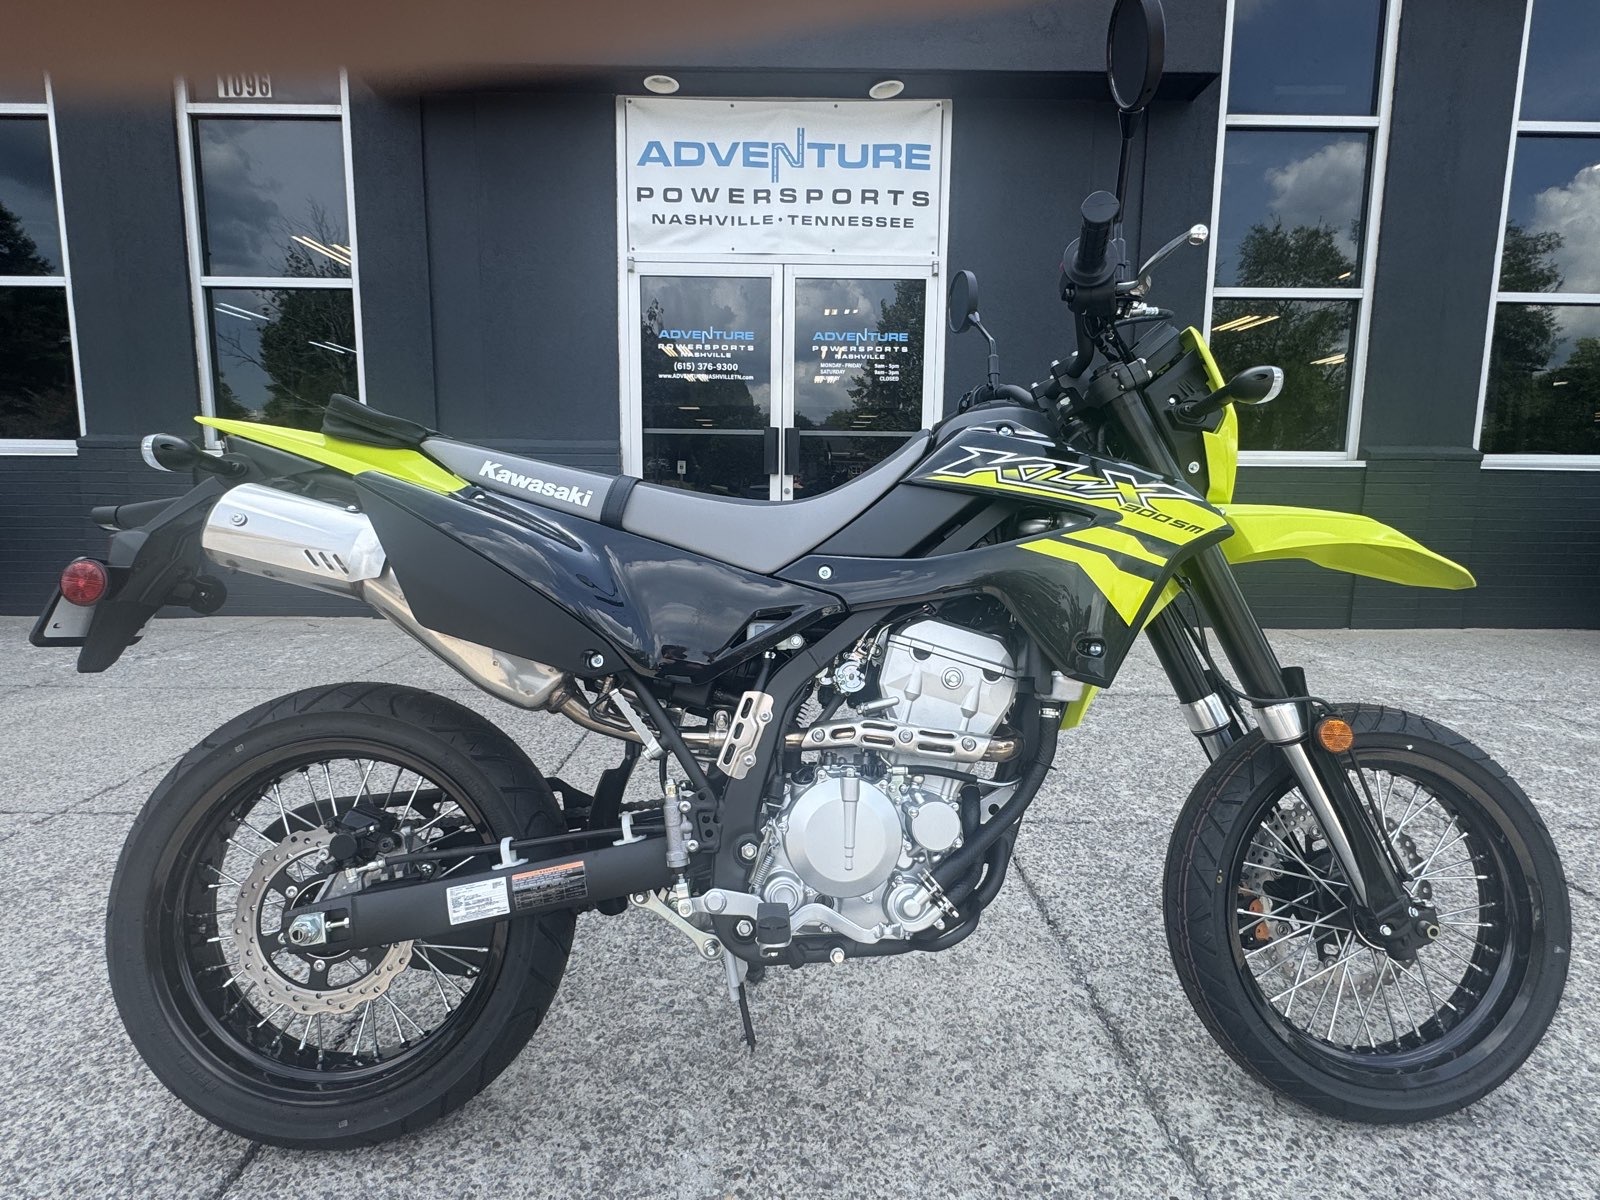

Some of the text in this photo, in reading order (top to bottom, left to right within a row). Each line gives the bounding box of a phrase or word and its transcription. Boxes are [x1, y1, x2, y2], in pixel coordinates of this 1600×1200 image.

[222, 73, 270, 97] 1096
[637, 128, 931, 183] ADVENTURE
[636, 187, 930, 207] POWERSPORTS
[658, 326, 755, 344] ADVENTURE
[812, 328, 909, 346] ADVENTURE
[657, 343, 754, 351] POWERSPORTS
[812, 345, 908, 353] POWERSPORTS
[673, 361, 739, 372] (615) 376-9300
[478, 460, 593, 507] Kawasaki
